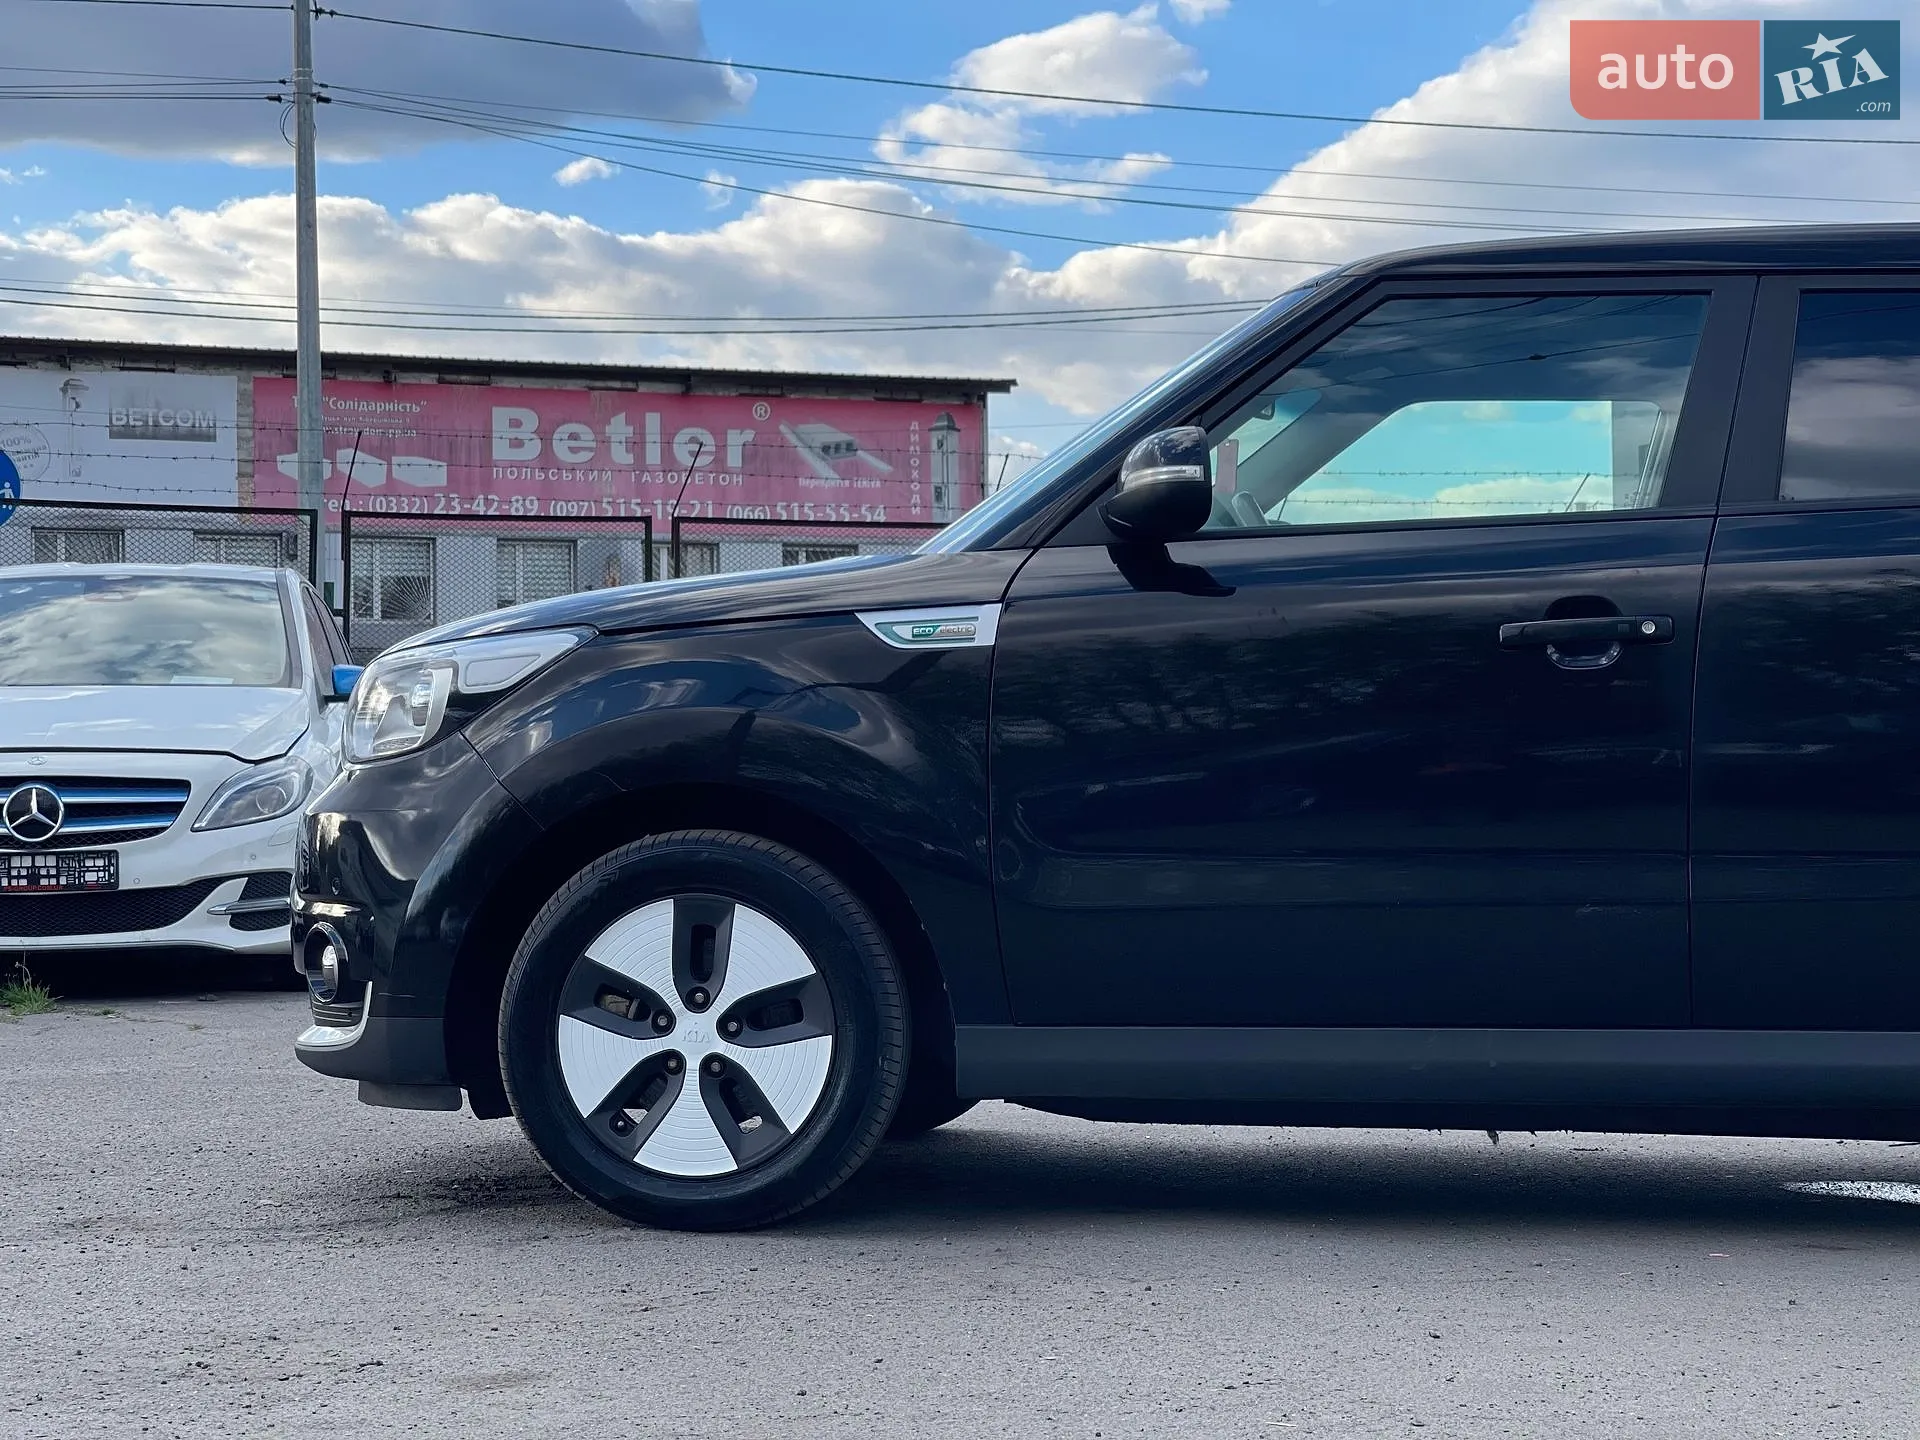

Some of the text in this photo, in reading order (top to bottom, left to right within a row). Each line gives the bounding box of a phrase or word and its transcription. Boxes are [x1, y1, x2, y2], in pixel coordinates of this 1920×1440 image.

[110, 407, 215, 428] BETCOM
[491, 406, 757, 468] Betler
[492, 466, 744, 486] ПОЛЬСЬКИЙ ГАЗОБЕТОН
[369, 495, 428, 514] (0332)
[550, 500, 596, 517] (097)
[913, 627, 933, 635] ECO
